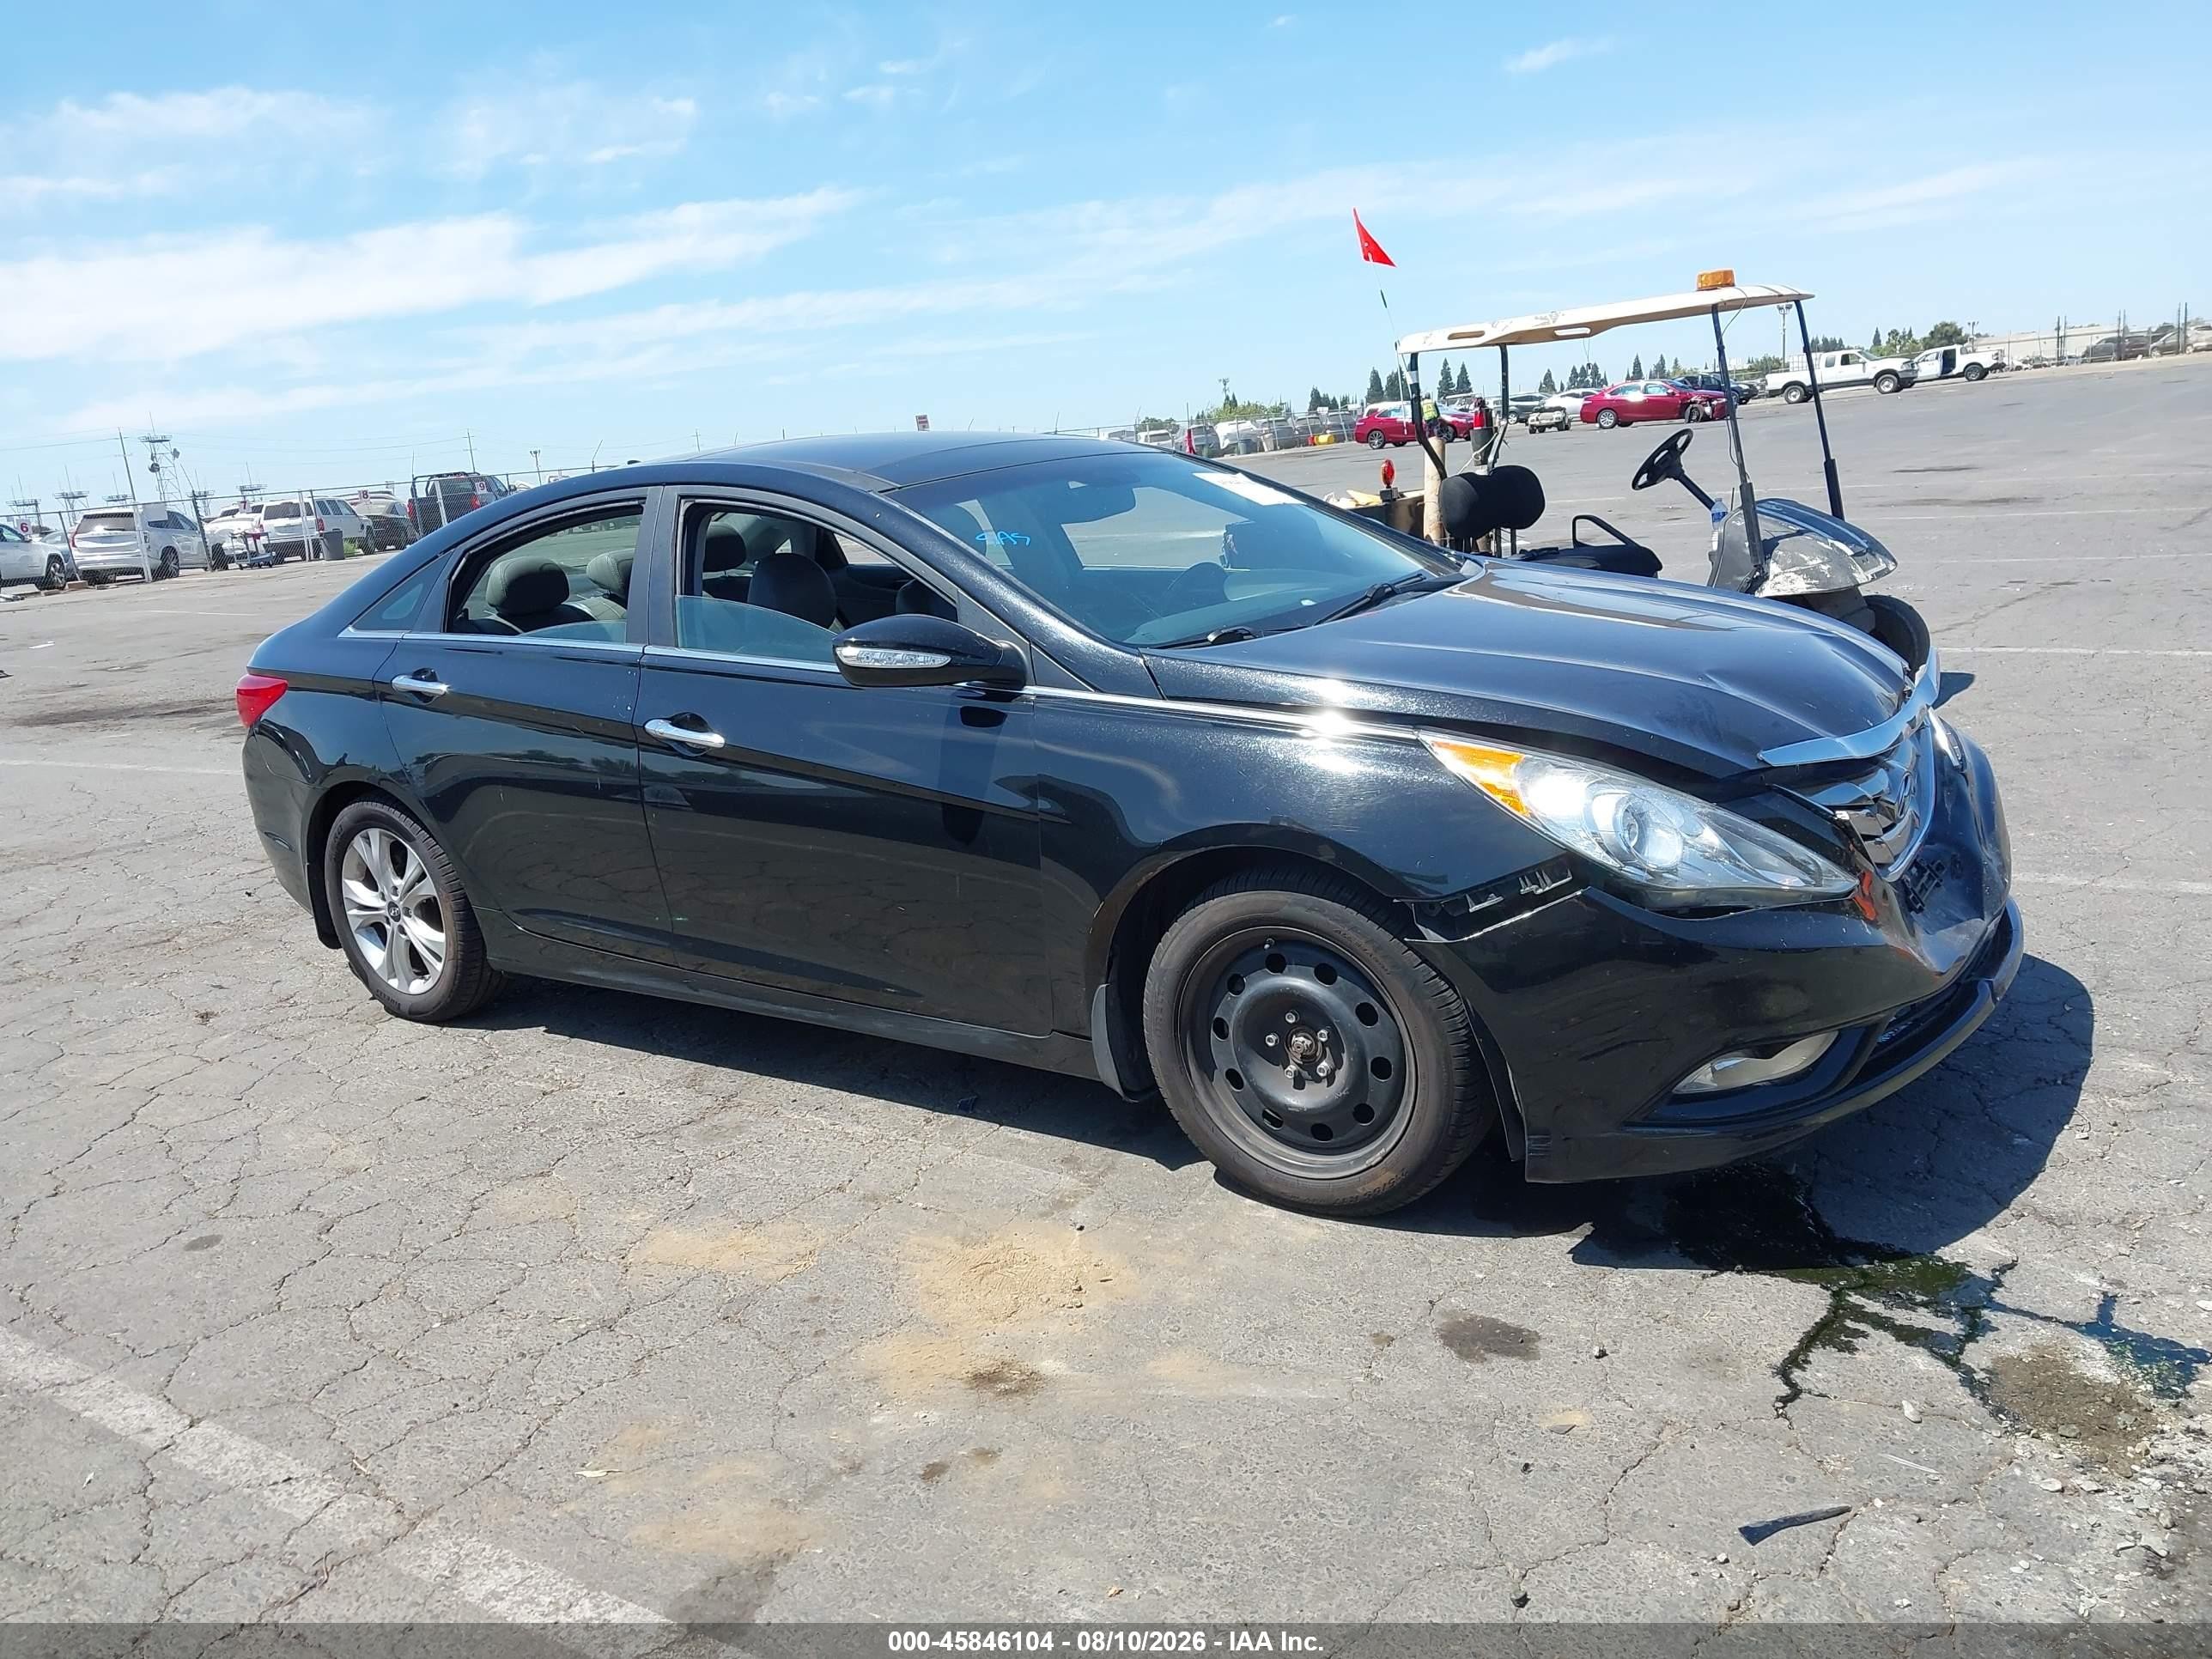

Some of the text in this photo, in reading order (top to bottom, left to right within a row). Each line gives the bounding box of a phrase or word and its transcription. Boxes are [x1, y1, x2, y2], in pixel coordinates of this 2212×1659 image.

[478, 482, 486, 491] 9
[362, 489, 369, 499] 8
[240, 501, 247, 509] 7
[20, 522, 29, 533] 6
